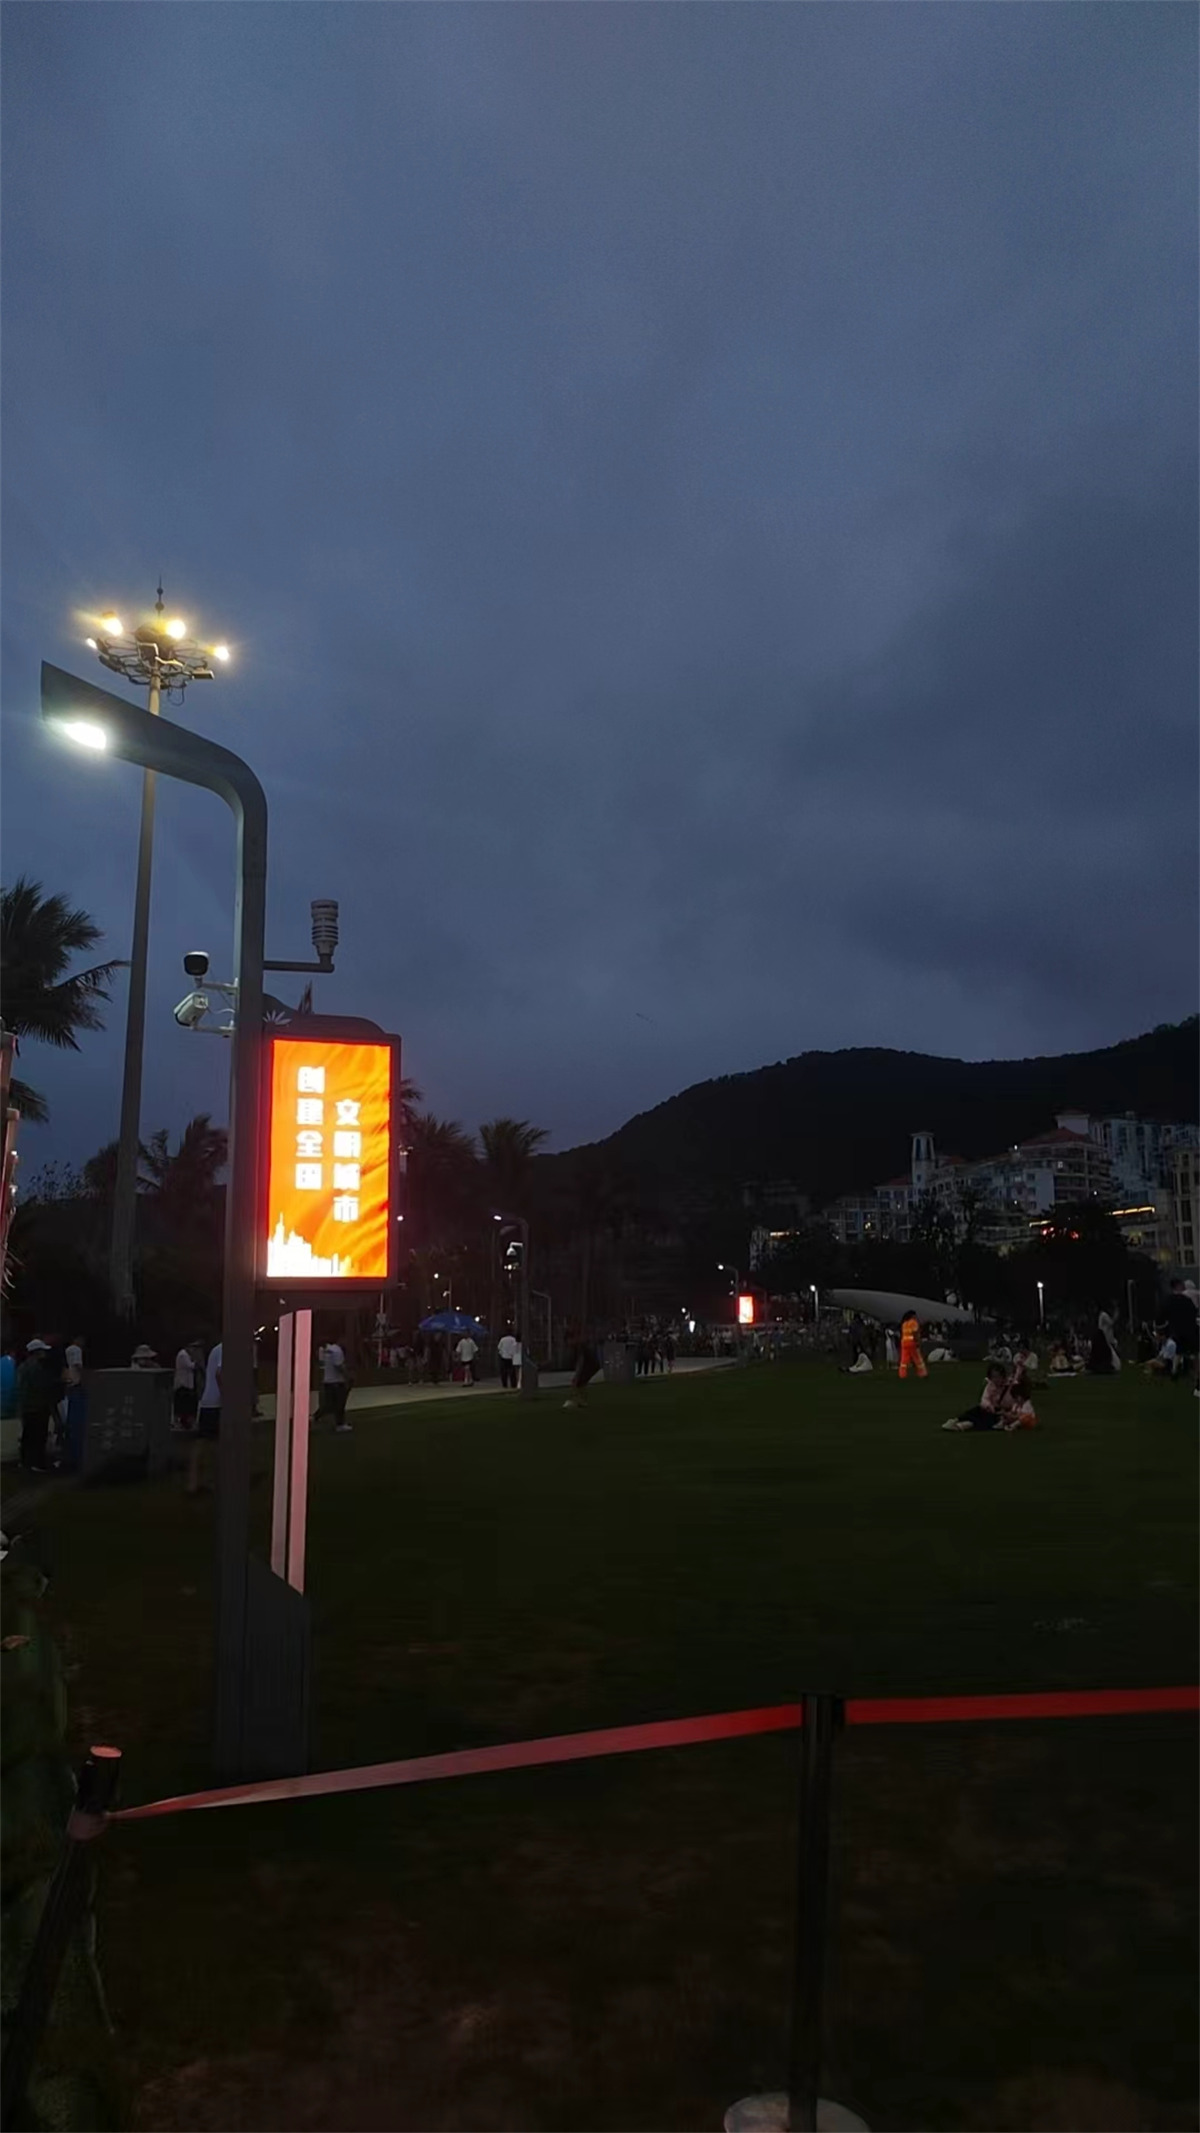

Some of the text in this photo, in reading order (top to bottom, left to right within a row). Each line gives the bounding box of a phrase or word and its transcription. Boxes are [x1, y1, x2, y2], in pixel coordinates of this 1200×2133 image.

[296, 1066, 325, 1190] 创建全国
[333, 1099, 361, 1222] 文明城市
